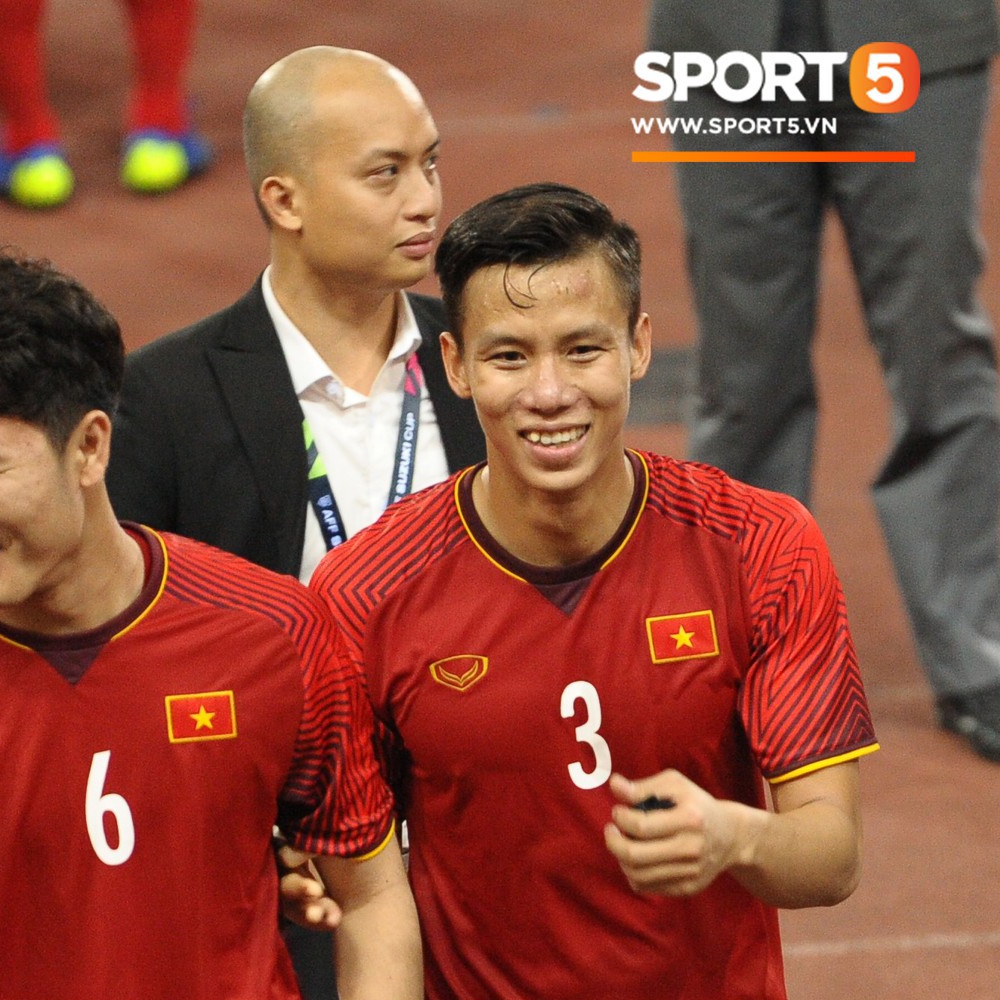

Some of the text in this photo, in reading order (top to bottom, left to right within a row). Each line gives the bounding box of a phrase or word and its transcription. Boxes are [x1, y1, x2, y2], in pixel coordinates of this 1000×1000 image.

[403, 412, 415, 441] CUP
[321, 509, 339, 533] AFF
[560, 680, 612, 790] 3
[85, 749, 135, 866] 6
